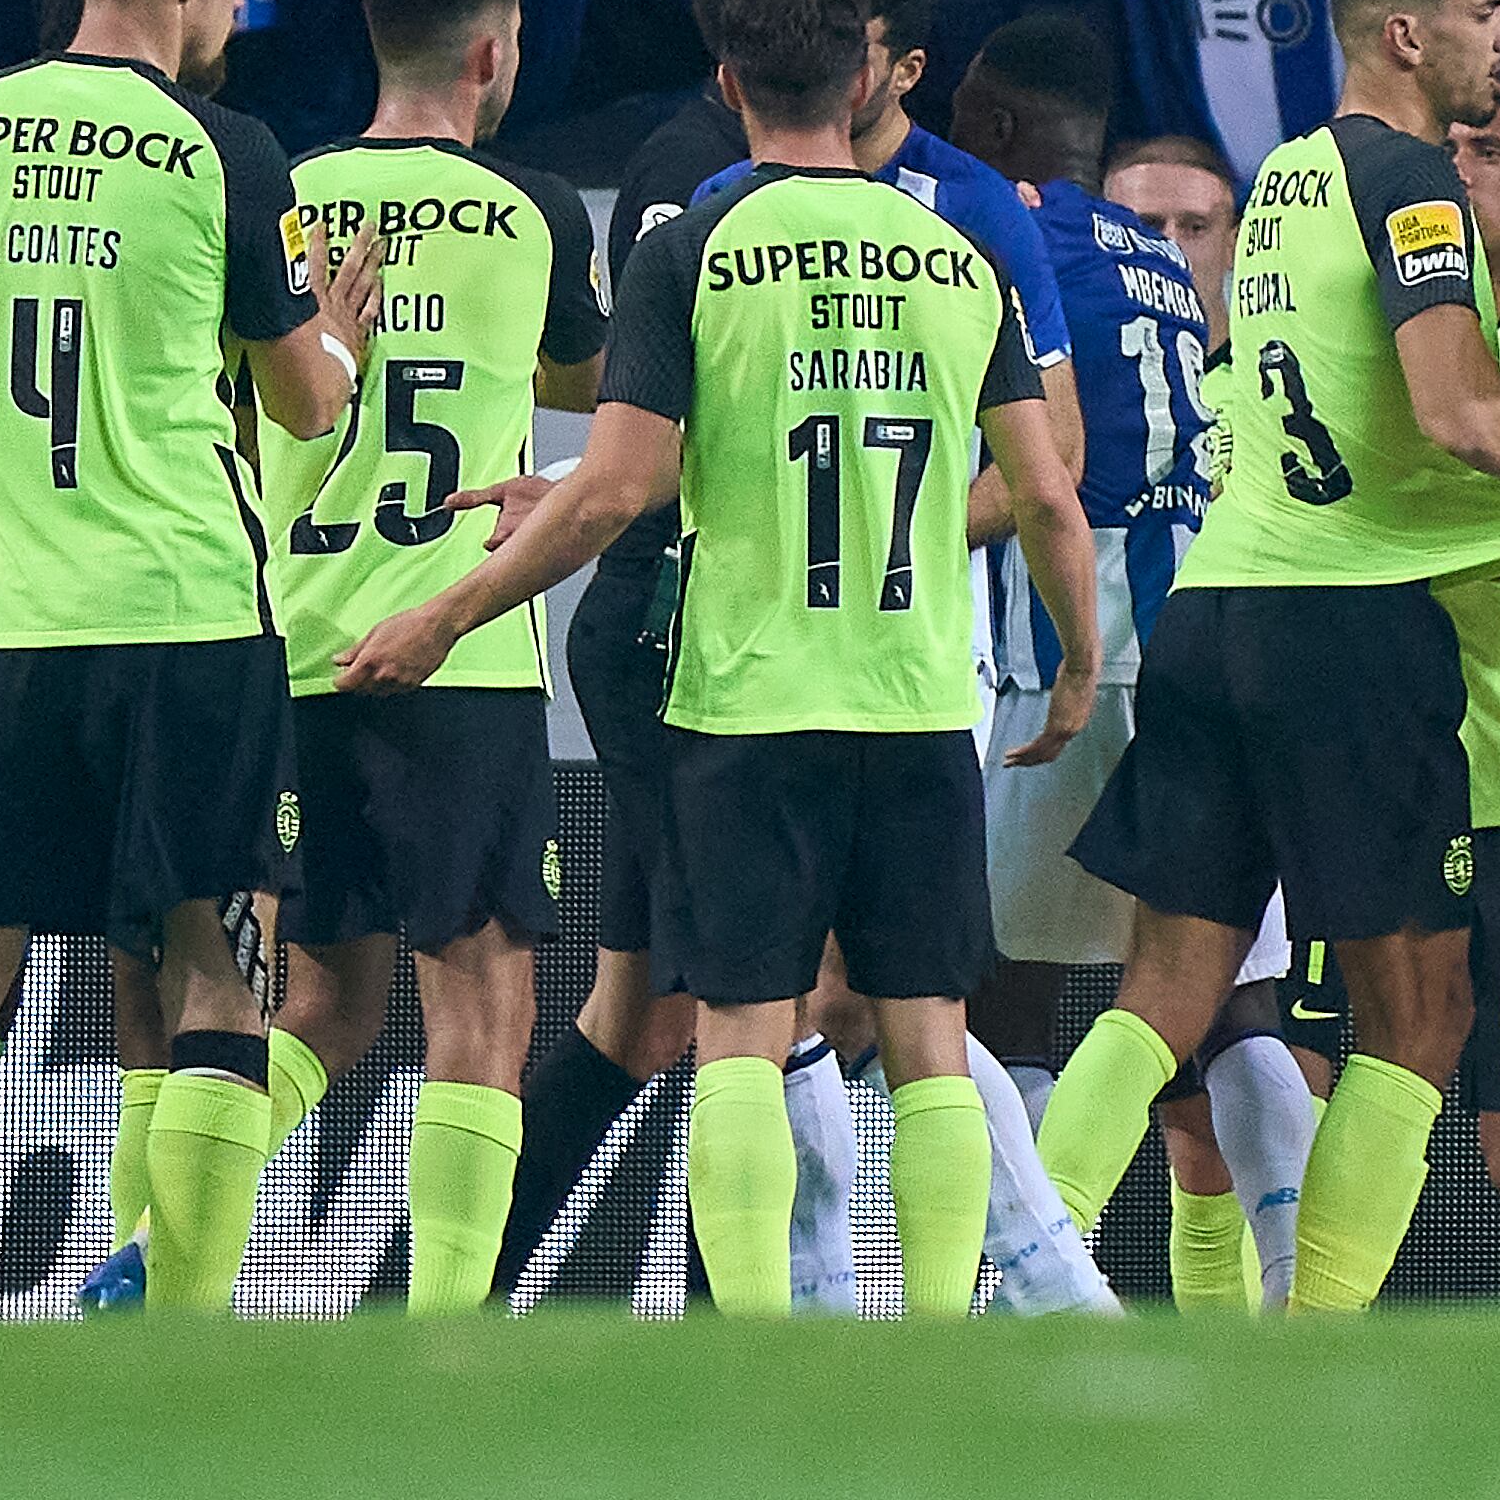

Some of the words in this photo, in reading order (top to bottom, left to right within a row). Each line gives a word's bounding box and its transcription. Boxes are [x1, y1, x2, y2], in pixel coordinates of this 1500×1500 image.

[68, 119, 204, 180] BOCK
[12, 164, 103, 203] STOUT
[1262, 169, 1334, 209] BOCK
[298, 198, 366, 241] PER
[377, 197, 519, 241] BOCK
[1396, 215, 1422, 233] LIGA
[1399, 222, 1453, 247] PORTUGAL
[7, 223, 122, 270] COATES
[707, 239, 851, 292] SUPER
[859, 240, 980, 290] BOCK
[1404, 247, 1468, 278] bwin
[810, 293, 907, 331] STOUT
[789, 349, 928, 392] SARABIA
[9, 297, 84, 489] 4
[1258, 338, 1354, 506] 3
[787, 414, 934, 612] 17
